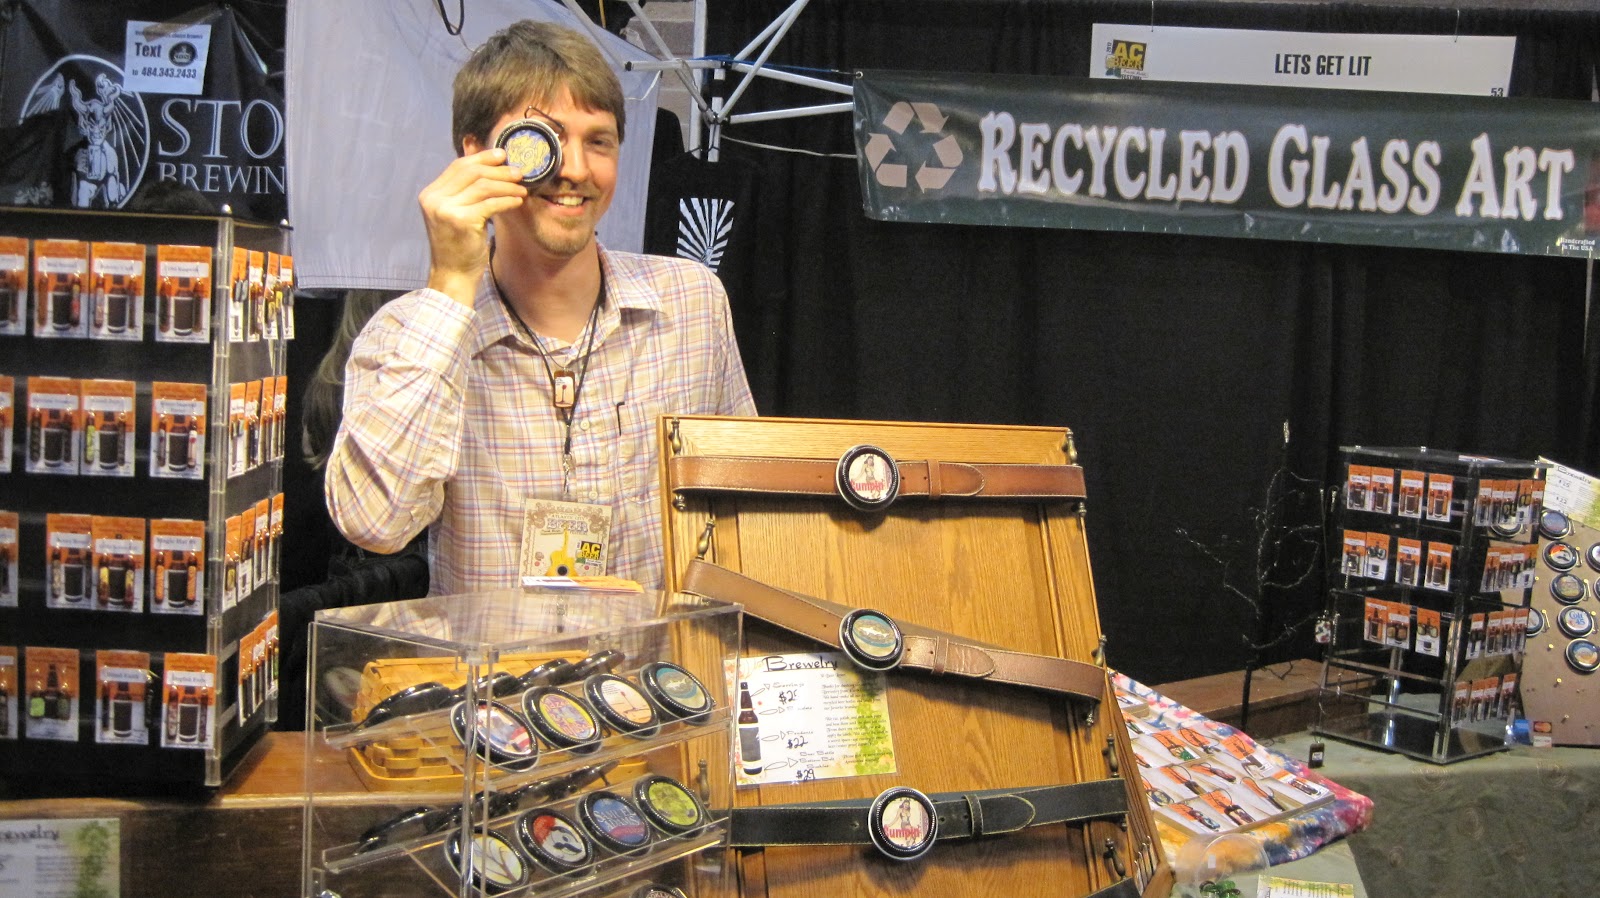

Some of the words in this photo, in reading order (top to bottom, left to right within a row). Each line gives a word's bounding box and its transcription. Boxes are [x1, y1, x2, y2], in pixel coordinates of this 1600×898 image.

[134, 42, 162, 58] Text
[1114, 42, 1144, 62] AC
[1114, 58, 1143, 70] BEER
[1275, 53, 1311, 75] LETS
[1316, 54, 1344, 75] GET
[1348, 56, 1372, 76] LIT
[141, 67, 197, 79] 484.343.2433
[1491, 88, 1504, 97] 53
[977, 111, 1251, 203] RECYCLED
[1267, 124, 1442, 216] GLASS
[1455, 132, 1575, 222] ART
[156, 162, 286, 194] BREWIN
[582, 543, 601, 554] AC
[1569, 610, 1583, 619] Colt
[762, 655, 838, 672] Brewelry
[787, 736, 808, 749] $22
